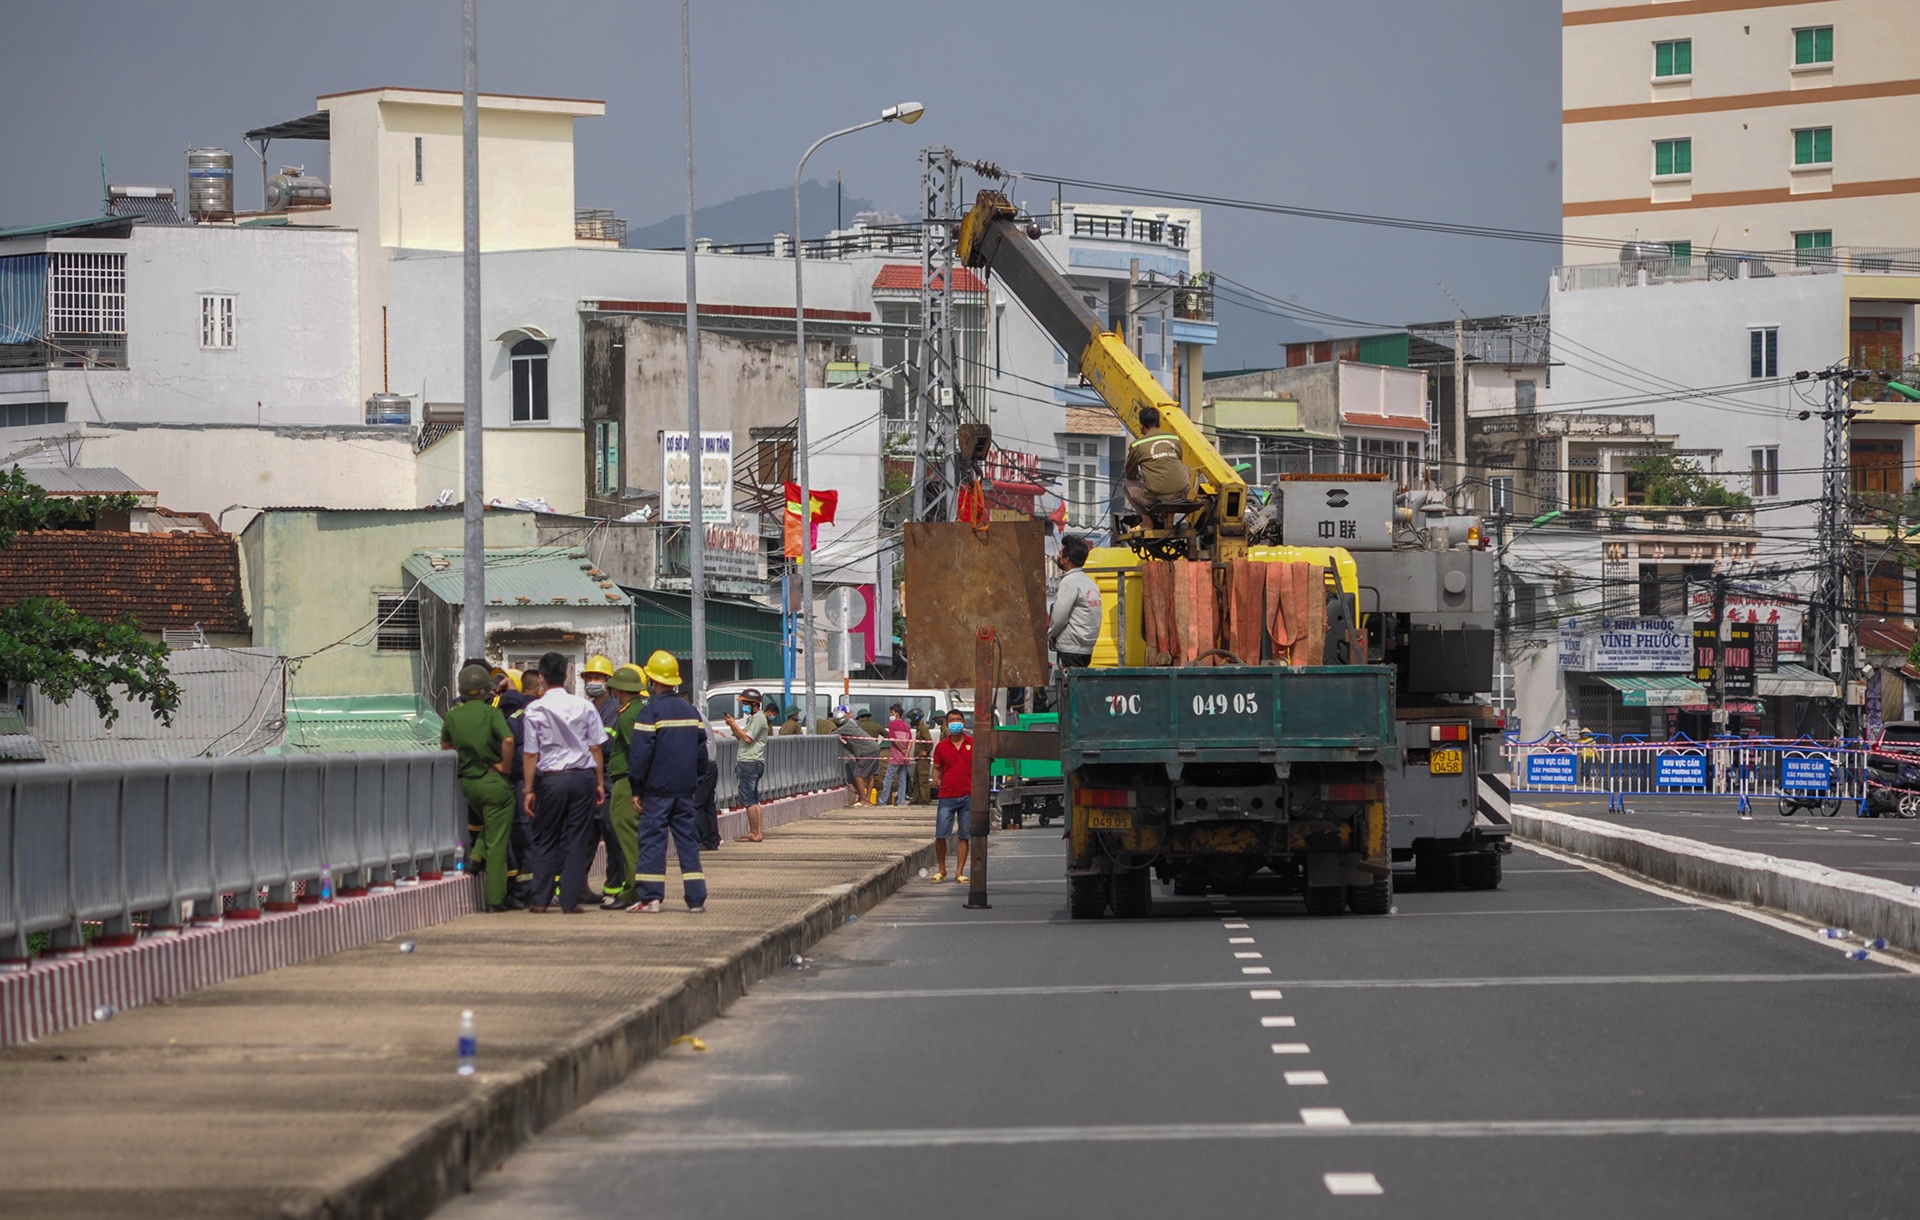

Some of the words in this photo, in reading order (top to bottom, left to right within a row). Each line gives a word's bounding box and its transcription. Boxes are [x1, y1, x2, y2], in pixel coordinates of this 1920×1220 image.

[1318, 520, 1356, 539] 中联
[1636, 631, 1681, 648] PHƯỚC
[1755, 631, 1774, 643] MỤN
[1192, 694, 1228, 715] 049
[1233, 693, 1258, 714] 05
[1433, 751, 1445, 762] 79
[1448, 751, 1460, 762] LA
[1546, 758, 1556, 766] VỰC
[1557, 757, 1570, 765] CẤM
[1434, 762, 1459, 772] 0458
[1675, 759, 1686, 767] VỰC
[1687, 758, 1699, 766] CẤM
[1812, 761, 1824, 770] CẤM
[1093, 817, 1127, 827] 049.05
